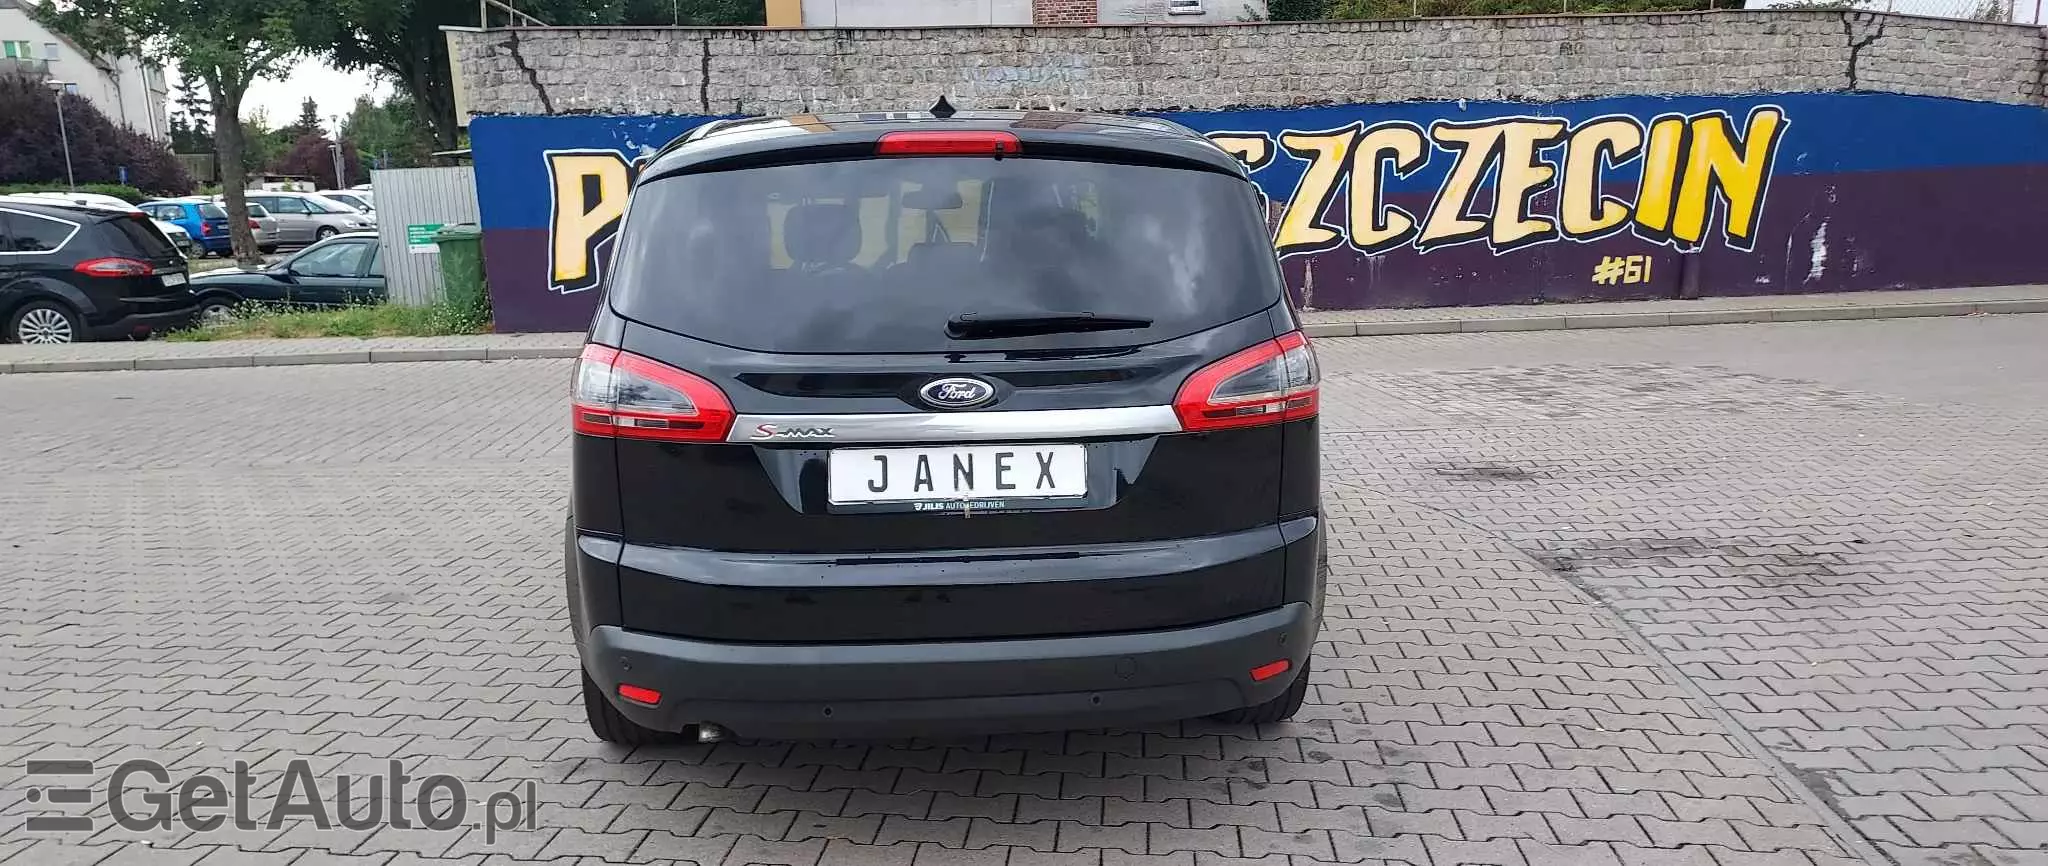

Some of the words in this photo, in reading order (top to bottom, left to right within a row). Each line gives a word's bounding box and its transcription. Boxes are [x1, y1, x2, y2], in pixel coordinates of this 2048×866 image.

[1206, 105, 1789, 255] ZCZECIN
[1591, 255, 1653, 286] #61
[937, 383, 977, 401] Ford
[751, 423, 836, 440] S-MAX
[867, 451, 1056, 493] JANEX
[922, 502, 945, 511] JILIS
[945, 500, 1005, 510] AUTOEDRIJVEN
